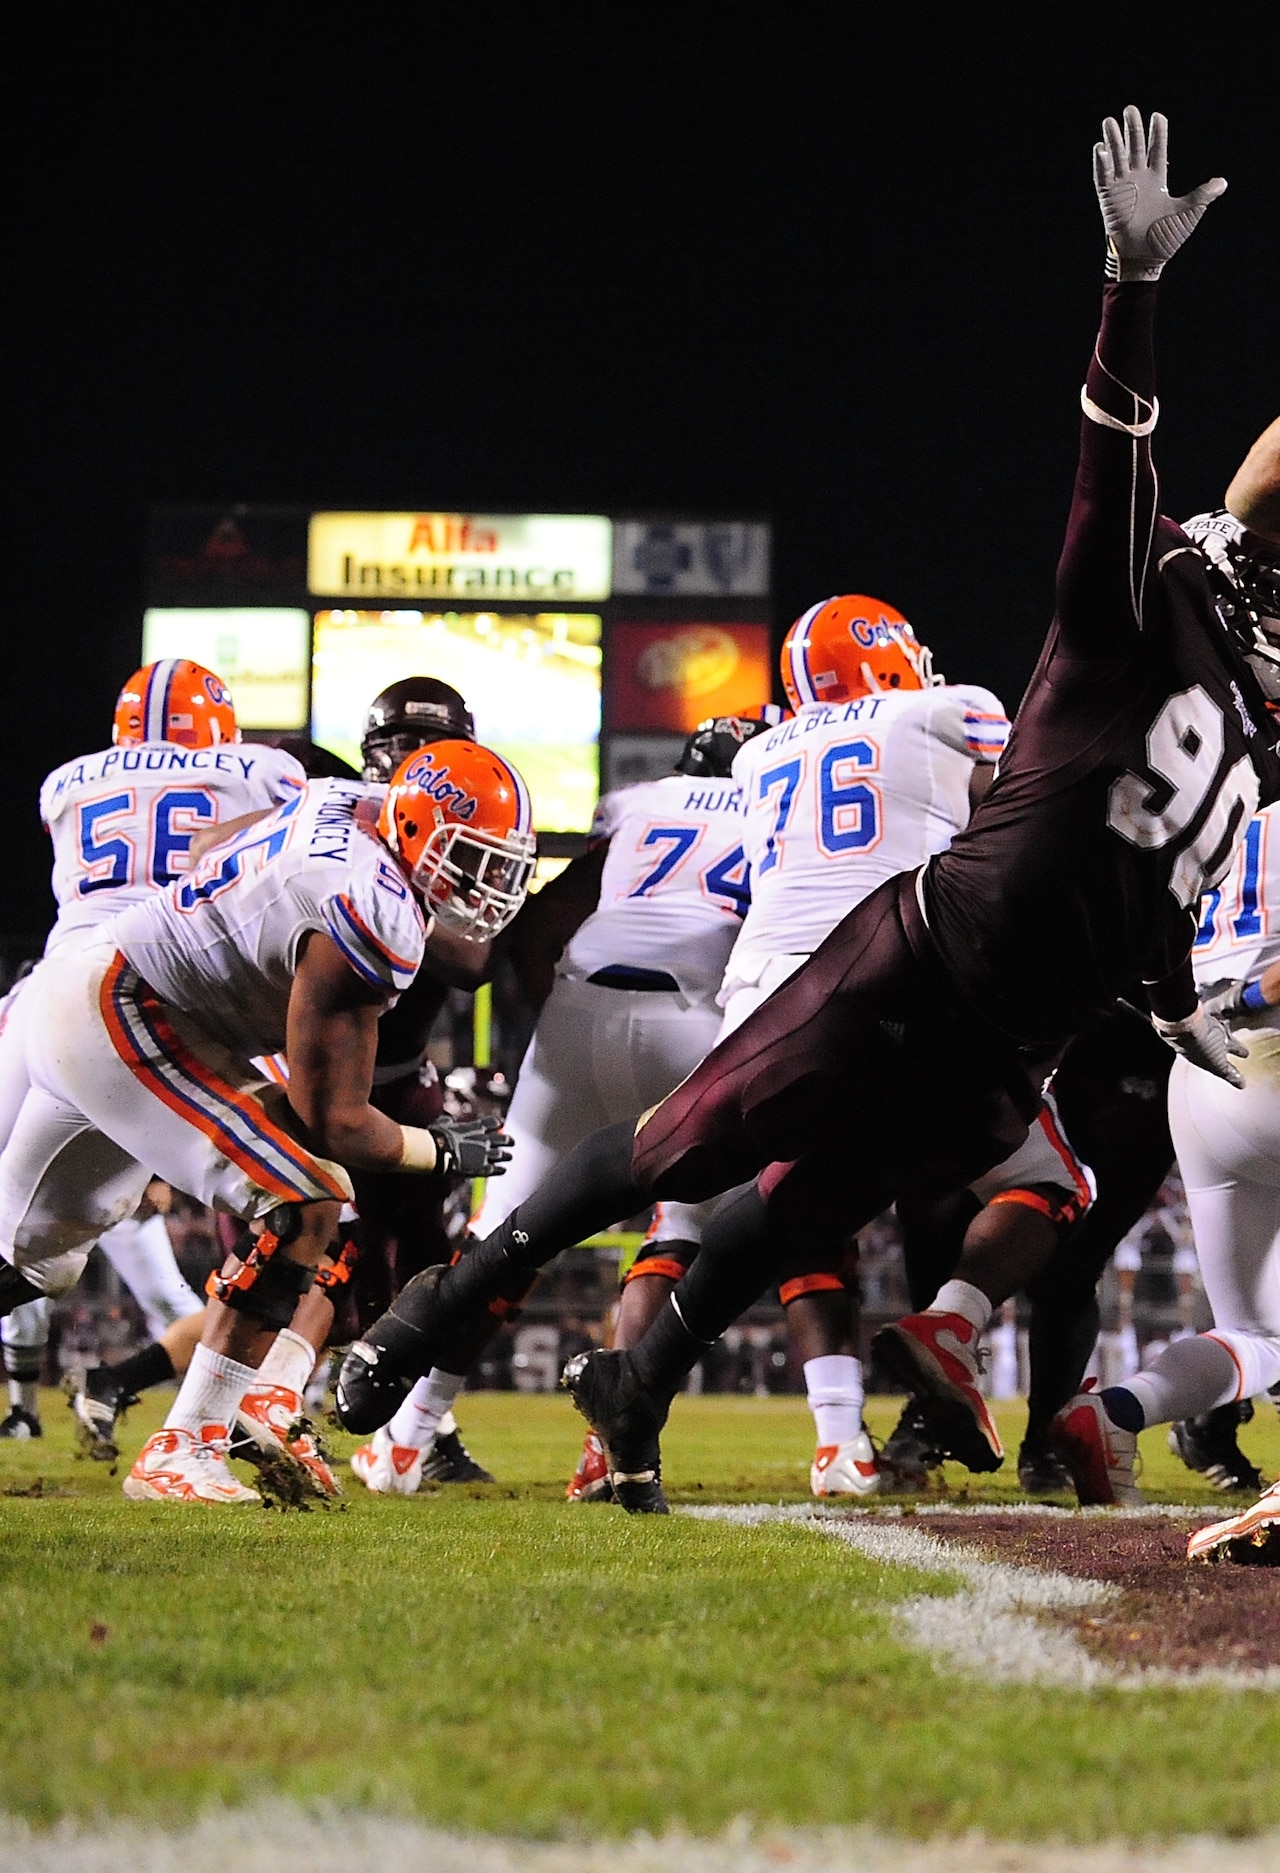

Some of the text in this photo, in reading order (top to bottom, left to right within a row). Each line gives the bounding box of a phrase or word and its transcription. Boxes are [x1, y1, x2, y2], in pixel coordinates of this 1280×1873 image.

[342, 553, 576, 588] Insurance
[408, 514, 498, 553] Alfa
[405, 752, 478, 821] Gators
[754, 733, 884, 879] 76
[1106, 683, 1262, 910] 90
[75, 784, 219, 900] 56
[614, 821, 751, 922] 74
